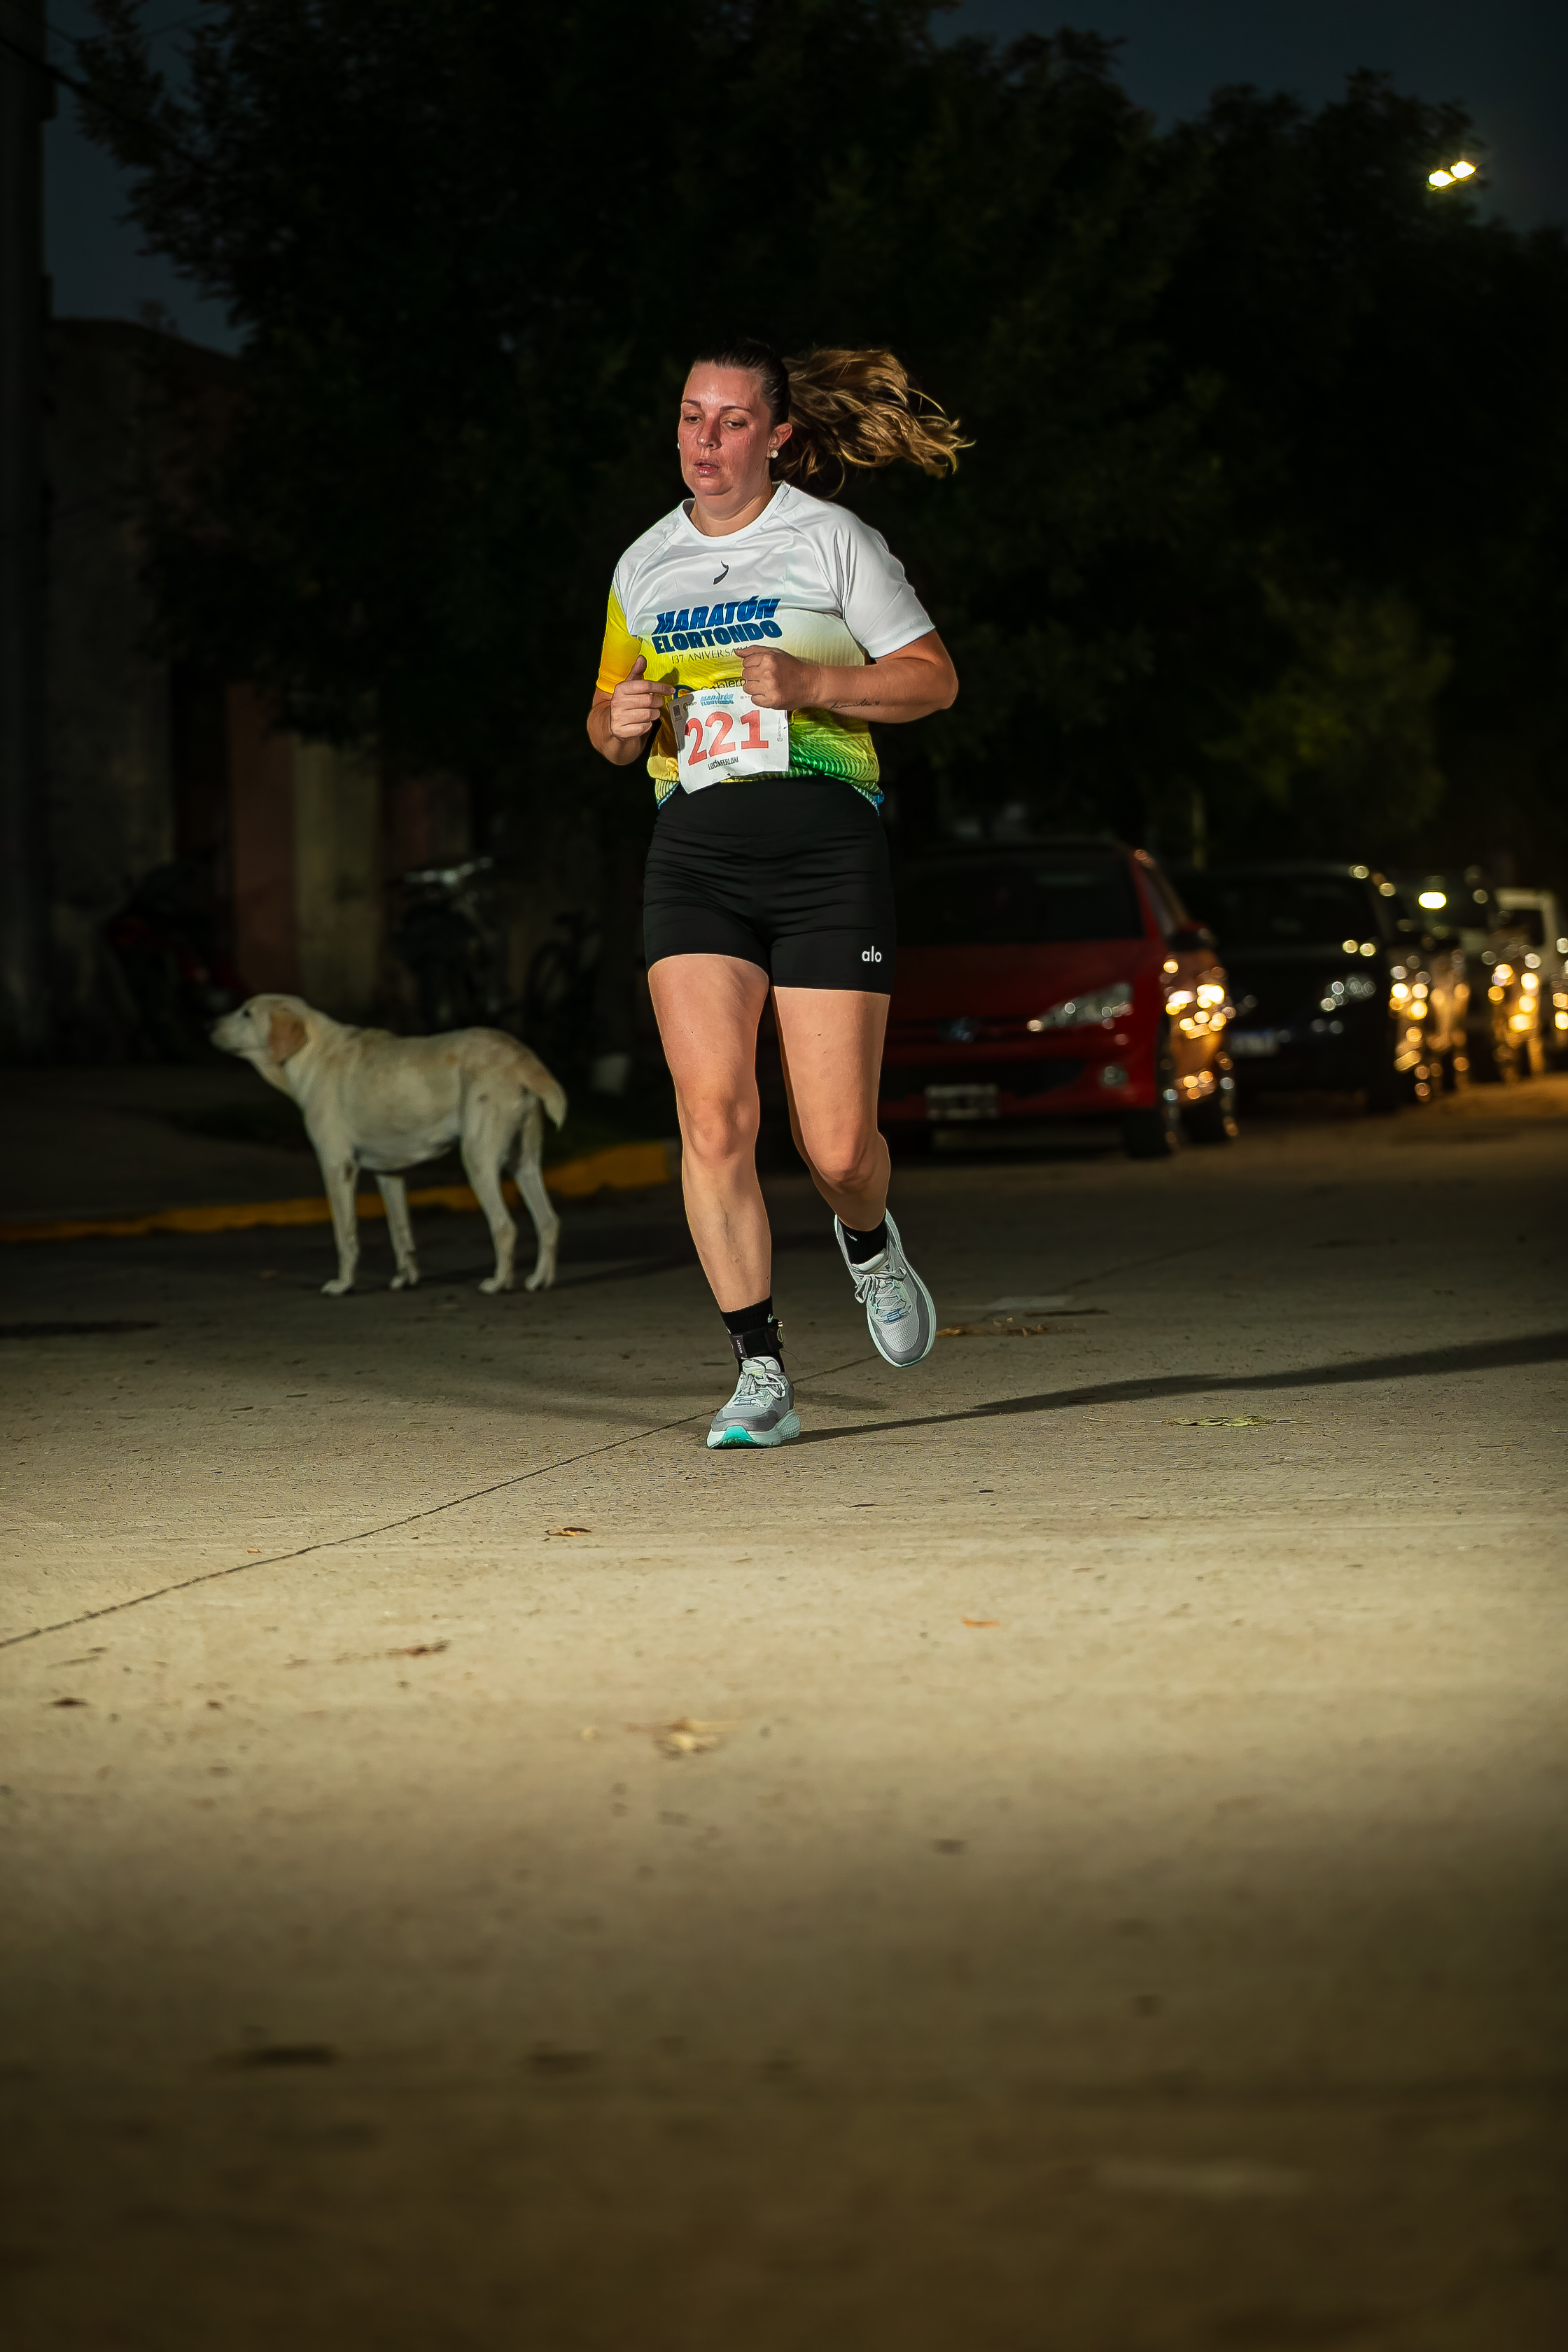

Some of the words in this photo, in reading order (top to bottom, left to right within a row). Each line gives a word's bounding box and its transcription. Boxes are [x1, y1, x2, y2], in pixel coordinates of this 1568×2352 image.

[652, 595, 781, 635] MARATÓN
[652, 620, 783, 654] ELORTONDO
[671, 654, 684, 664] 137
[684, 710, 769, 766] 221
[862, 945, 882, 962] alo
